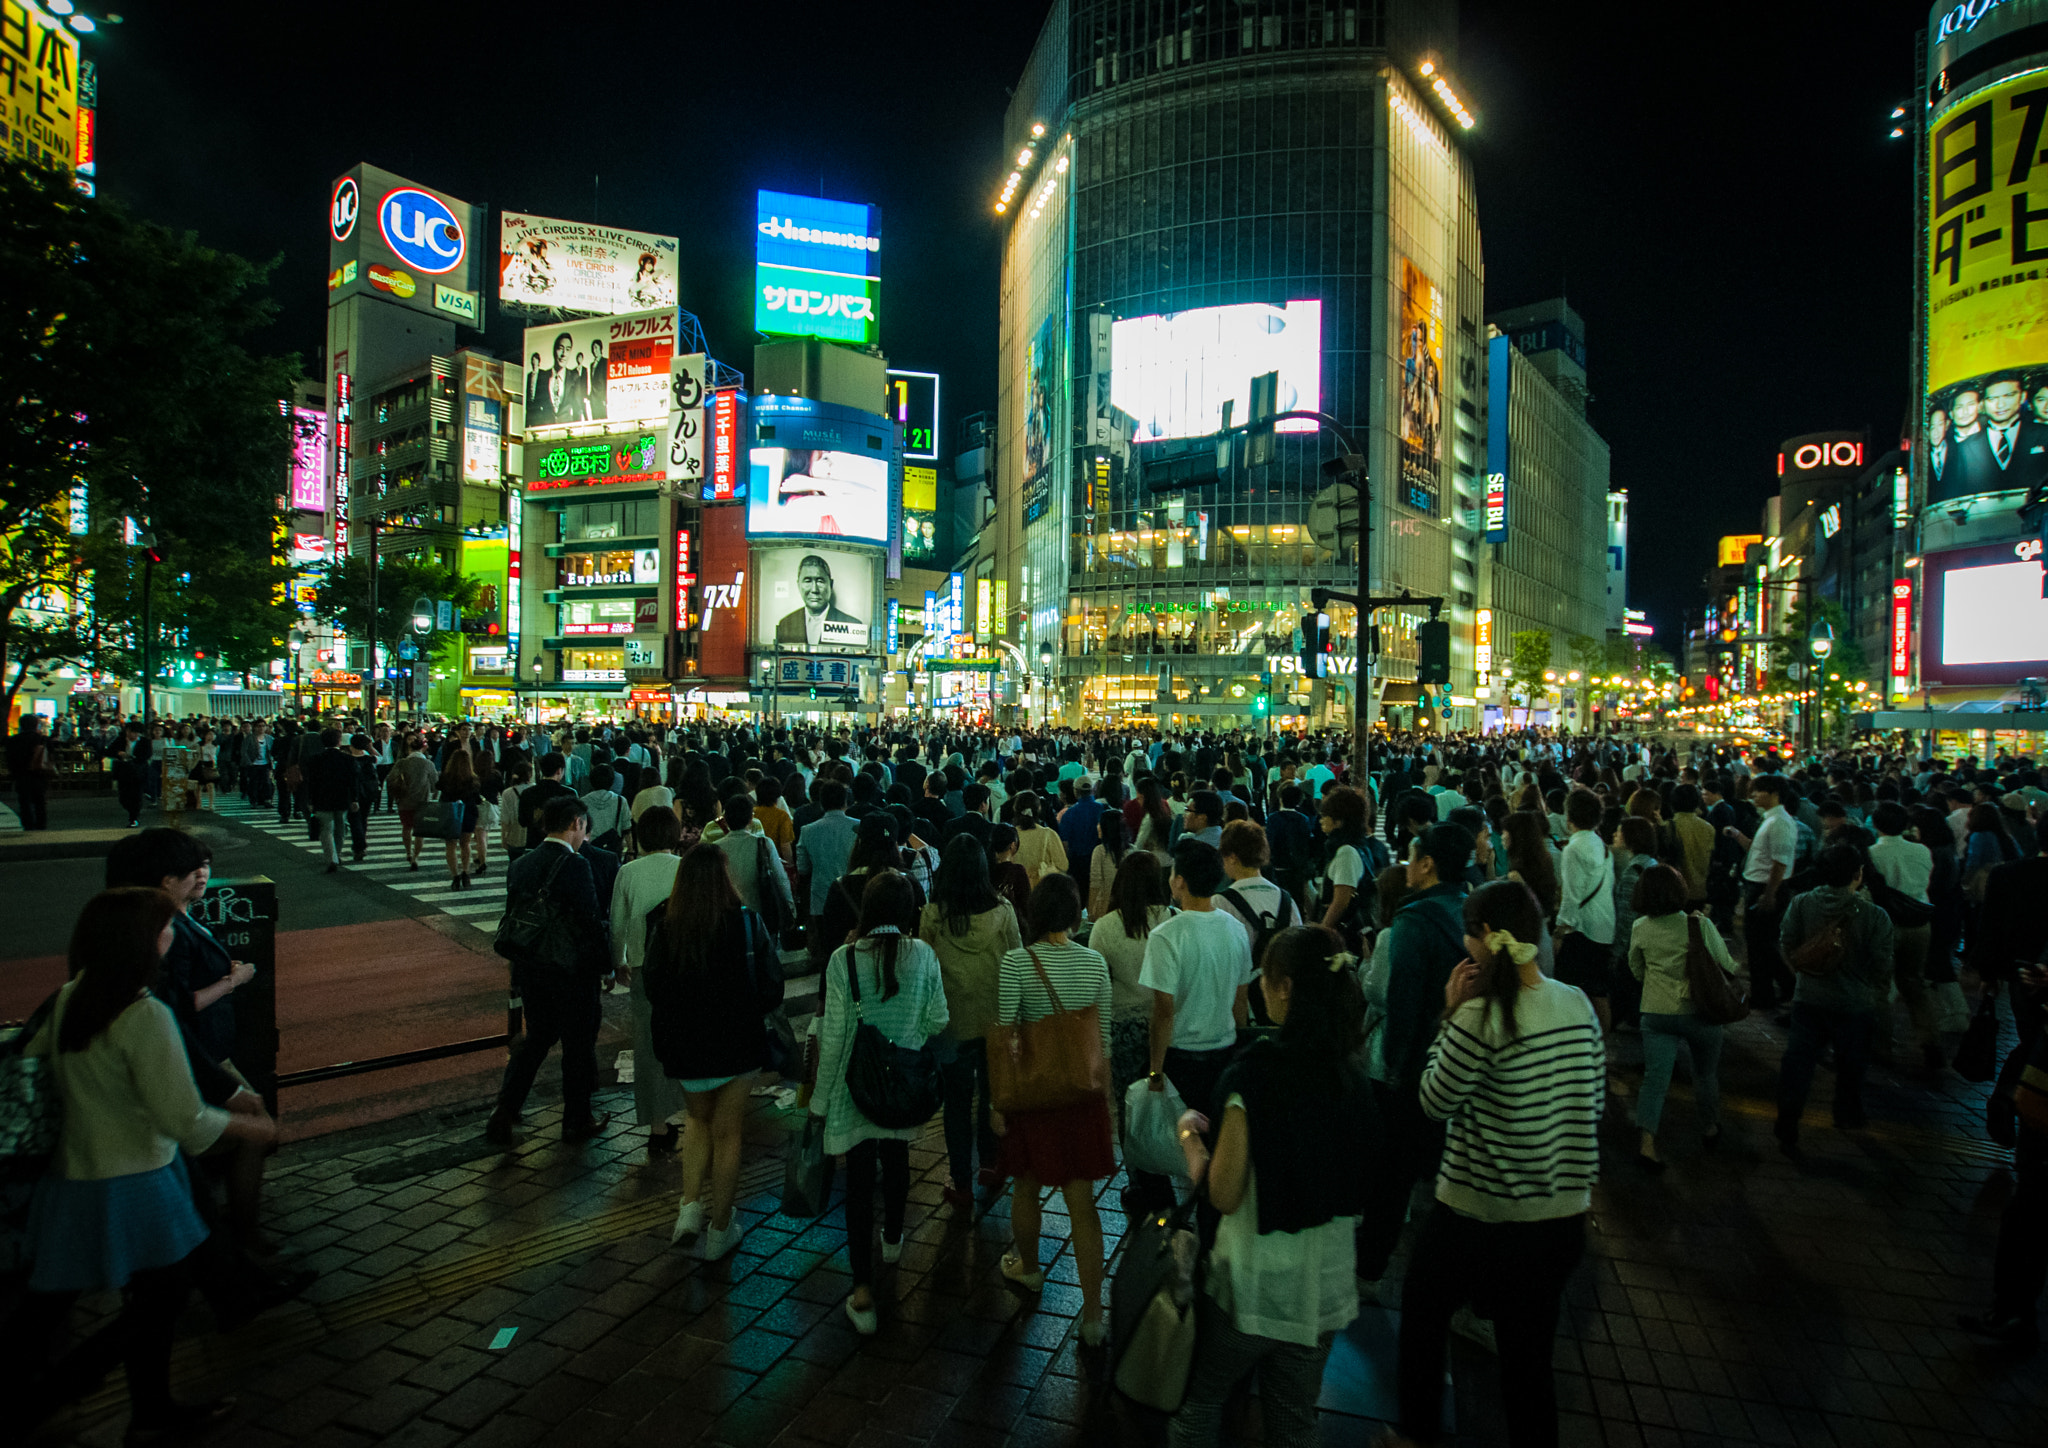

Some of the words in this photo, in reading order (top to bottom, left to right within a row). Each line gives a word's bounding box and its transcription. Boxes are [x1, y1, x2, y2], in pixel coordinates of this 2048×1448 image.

[391, 201, 458, 258] UC
[516, 227, 541, 240] LIVE
[542, 225, 585, 235] CIRCUS
[598, 229, 625, 243] LIVE
[368, 270, 416, 291] MasterCard
[440, 291, 473, 312] VISA
[763, 285, 875, 322] サロンパス
[610, 313, 675, 340] ウルフルズ
[610, 350, 627, 363] ONE
[628, 347, 652, 361] MIND
[609, 362, 627, 378] 5.21
[628, 364, 652, 376] Release
[672, 368, 703, 475] もんじゃ
[715, 396, 731, 493] 三千里薬品
[571, 453, 611, 476] 西村
[1486, 472, 1504, 531] SEIBU
[567, 571, 632, 587] Euphoria
[636, 602, 657, 618] JTB
[1126, 601, 1219, 615] STARBUCKS
[1226, 600, 1288, 614] COFFEE
[823, 623, 867, 636] DMM.com
